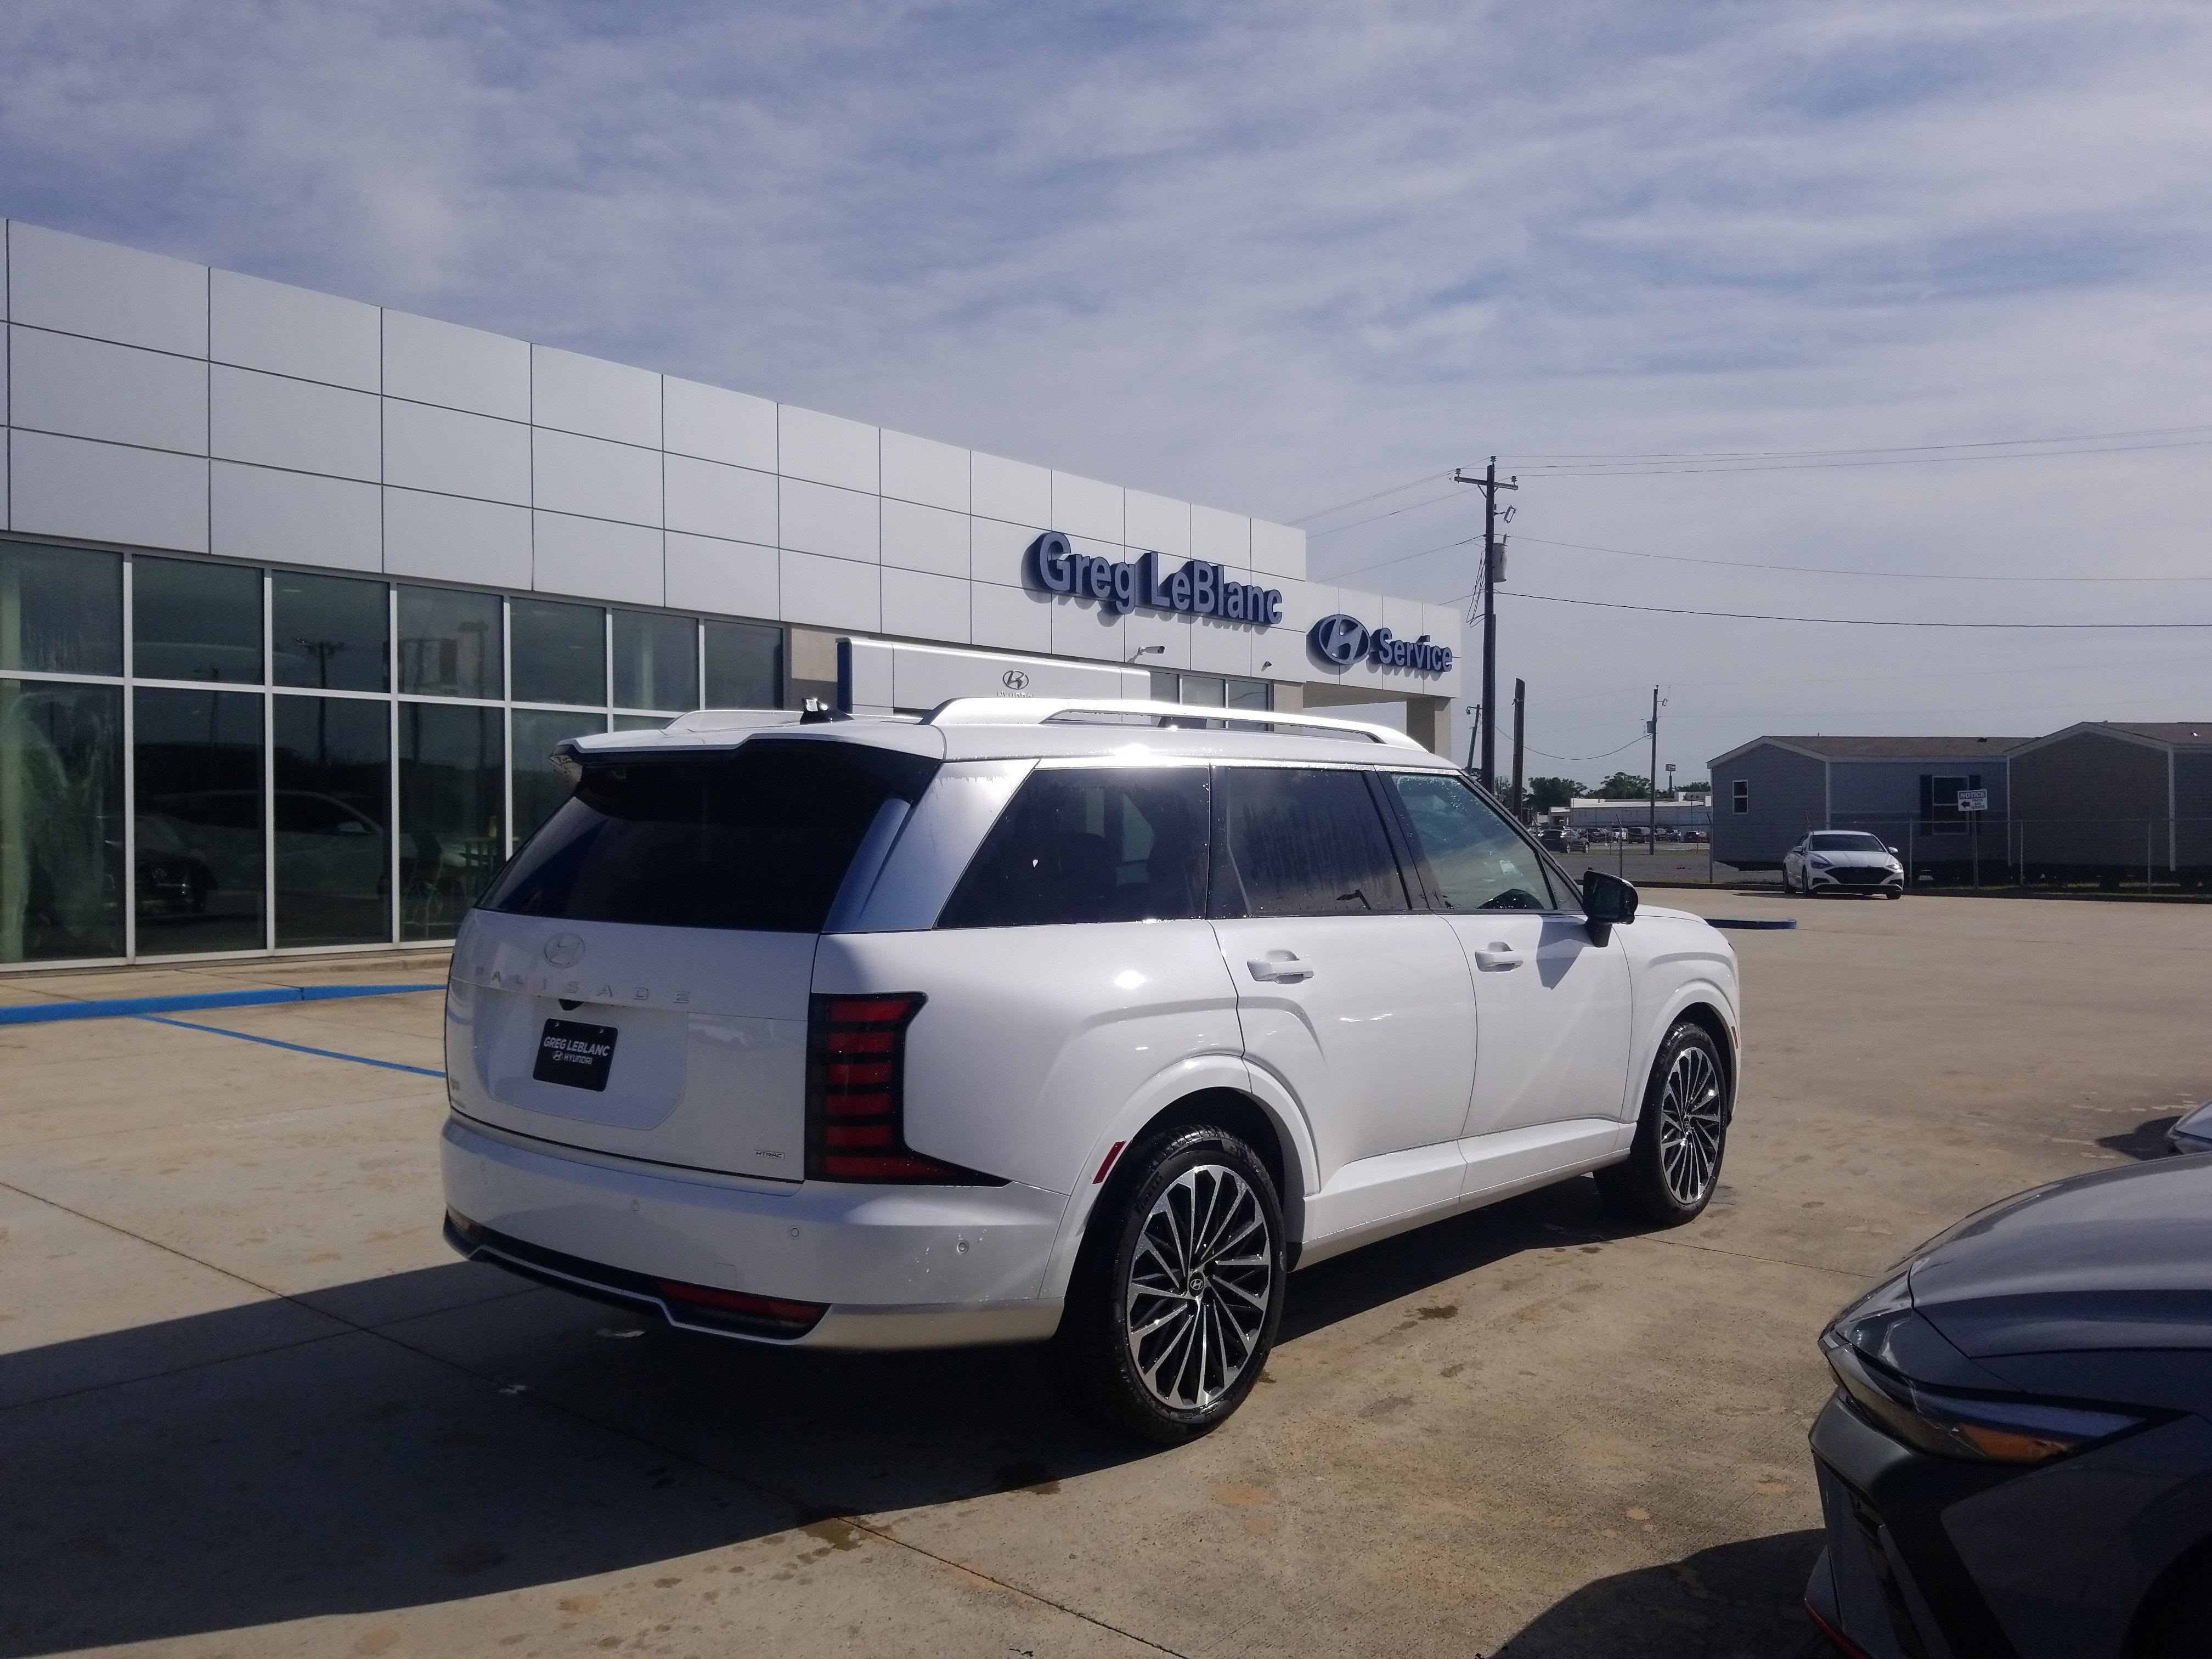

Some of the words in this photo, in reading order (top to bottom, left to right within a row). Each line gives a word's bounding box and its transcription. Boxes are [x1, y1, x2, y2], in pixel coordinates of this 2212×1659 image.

[1036, 531, 1136, 615] Greg
[1150, 551, 1283, 624] LeBlanc
[1378, 627, 1453, 672] Service
[475, 966, 690, 1004] PALISADE
[544, 1036, 567, 1049] GREG
[566, 1040, 610, 1057] LEBLANC
[563, 1053, 594, 1065] HYUNDAI
